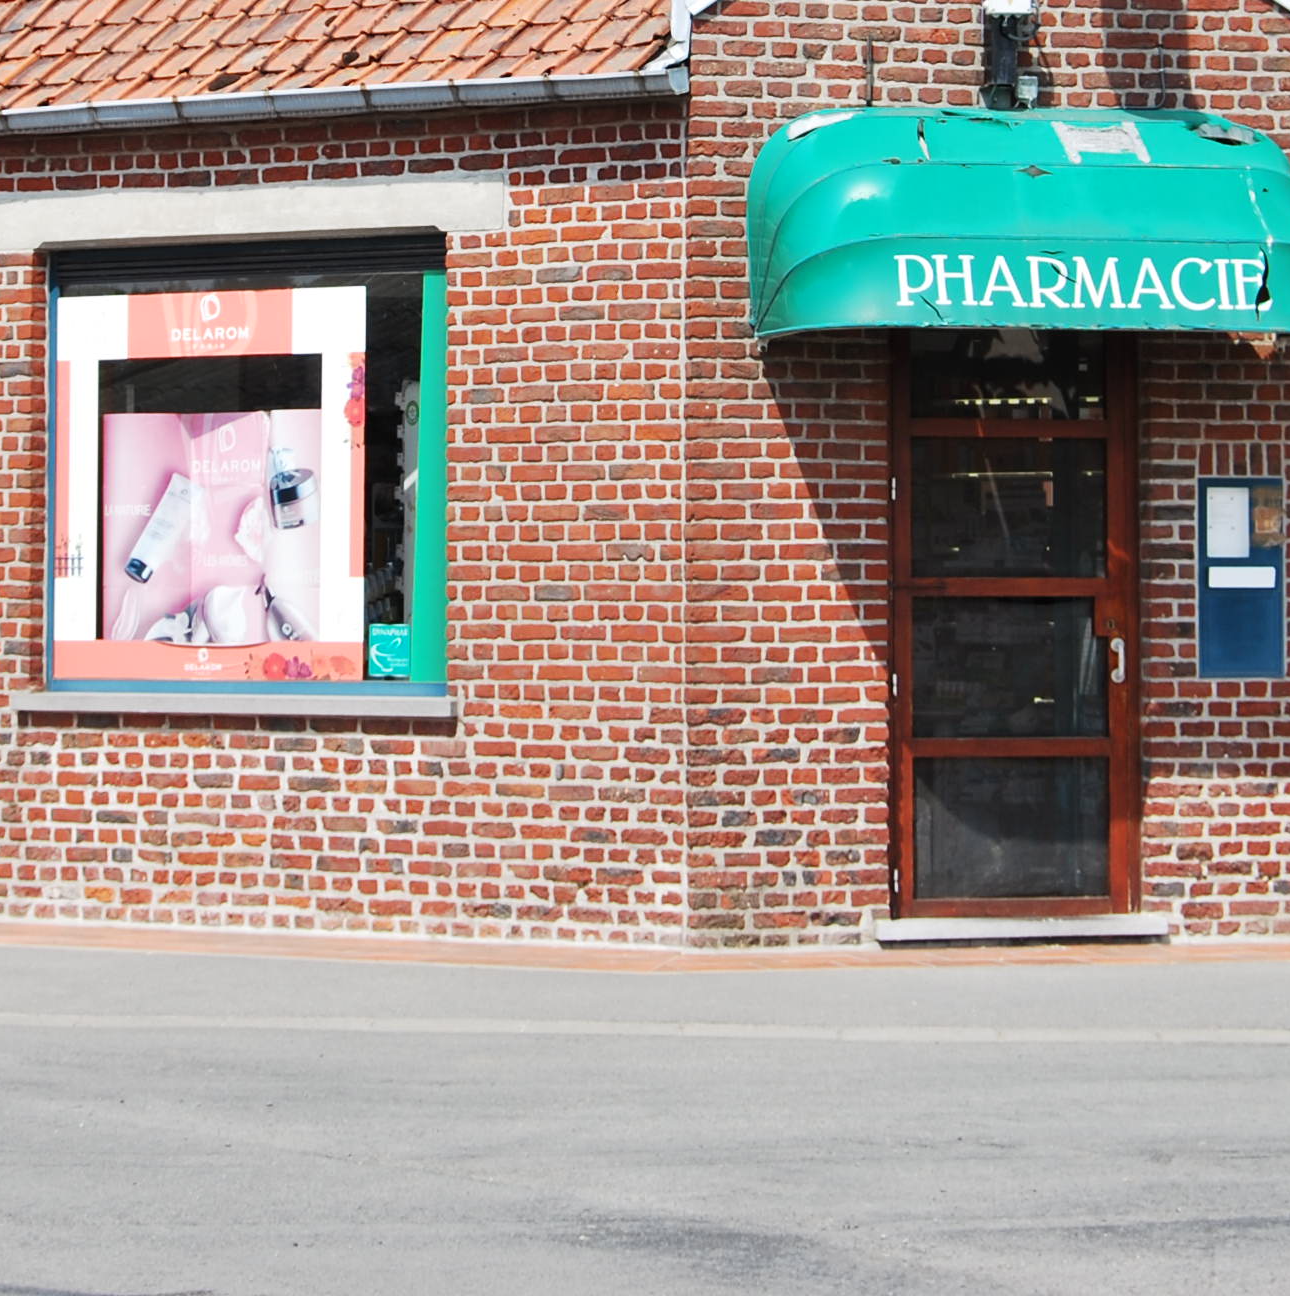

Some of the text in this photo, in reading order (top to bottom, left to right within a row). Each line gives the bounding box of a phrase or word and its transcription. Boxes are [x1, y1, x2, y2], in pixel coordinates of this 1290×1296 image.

[893, 253, 1274, 311] PHARMACIE
[170, 326, 250, 341] DELAROM
[191, 459, 261, 473] DELAROM
